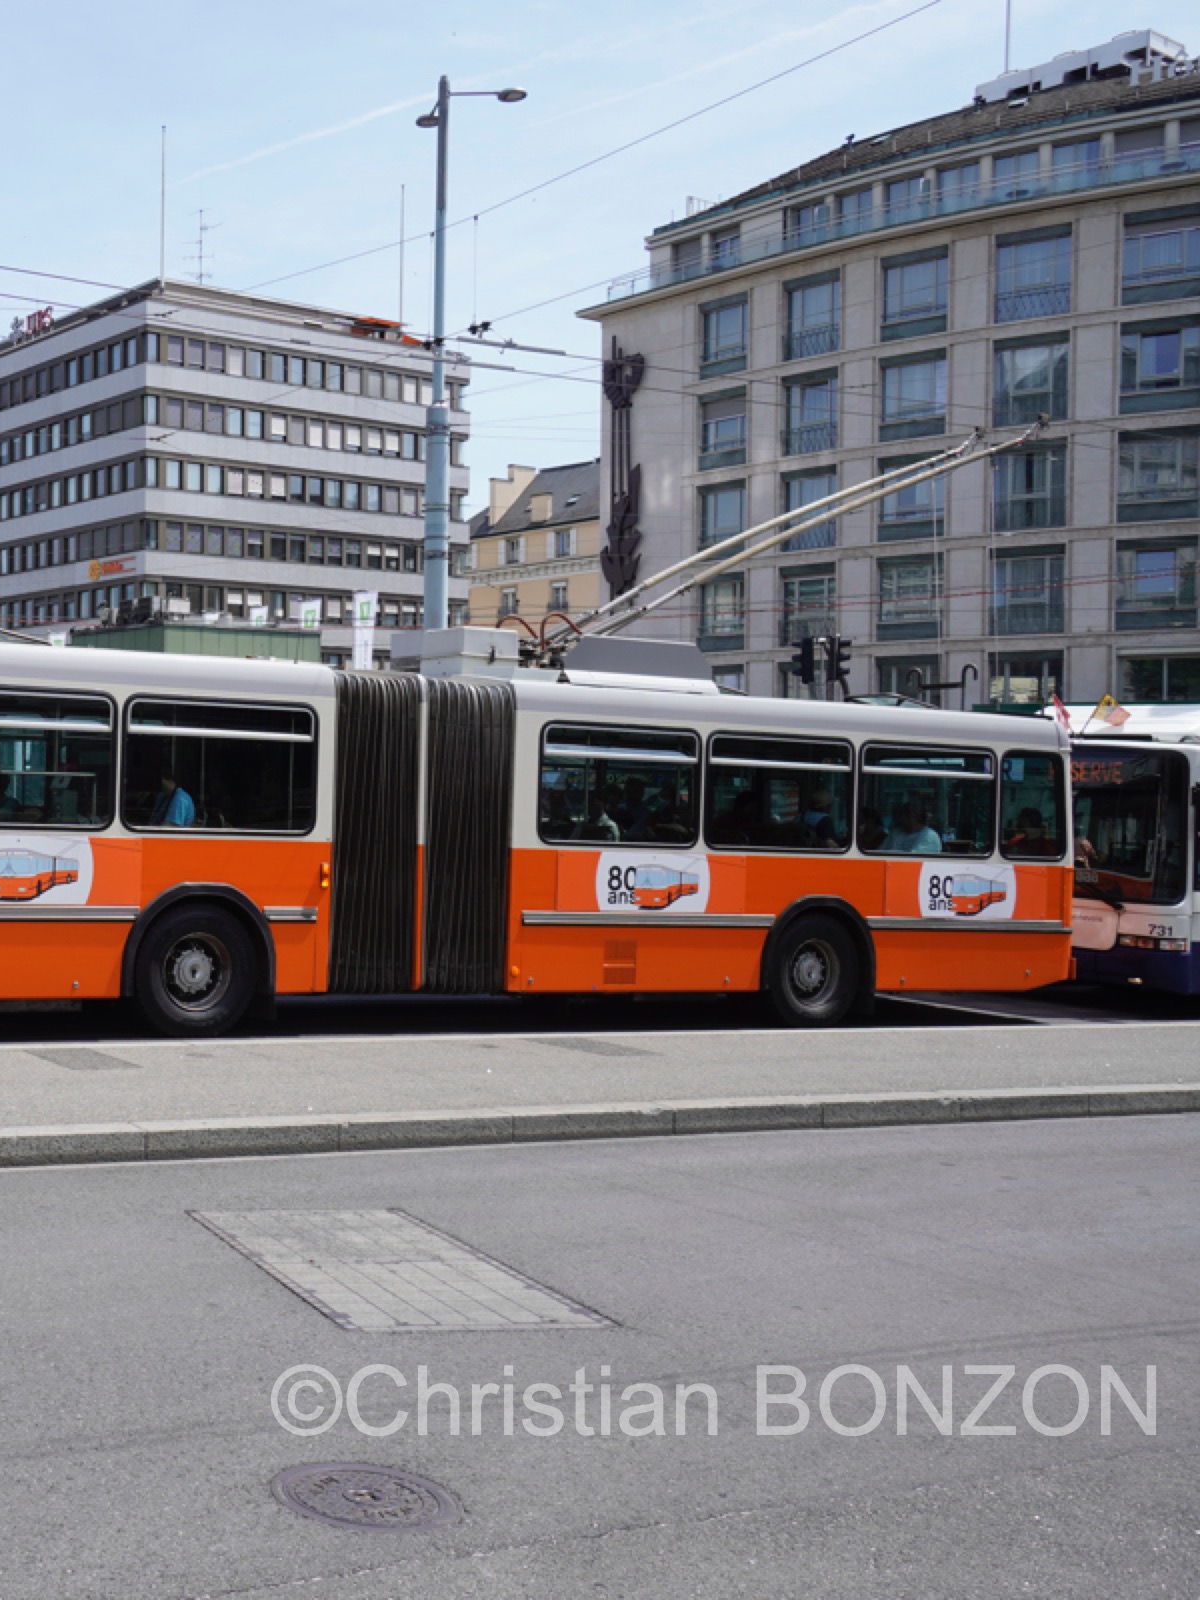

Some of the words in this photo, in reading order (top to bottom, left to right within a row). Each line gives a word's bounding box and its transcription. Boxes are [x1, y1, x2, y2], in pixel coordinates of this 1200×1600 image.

[608, 865, 637, 891] 80
[928, 875, 954, 899] 80
[608, 891, 636, 904] ans
[928, 899, 953, 911] ans
[1147, 923, 1173, 937] 731
